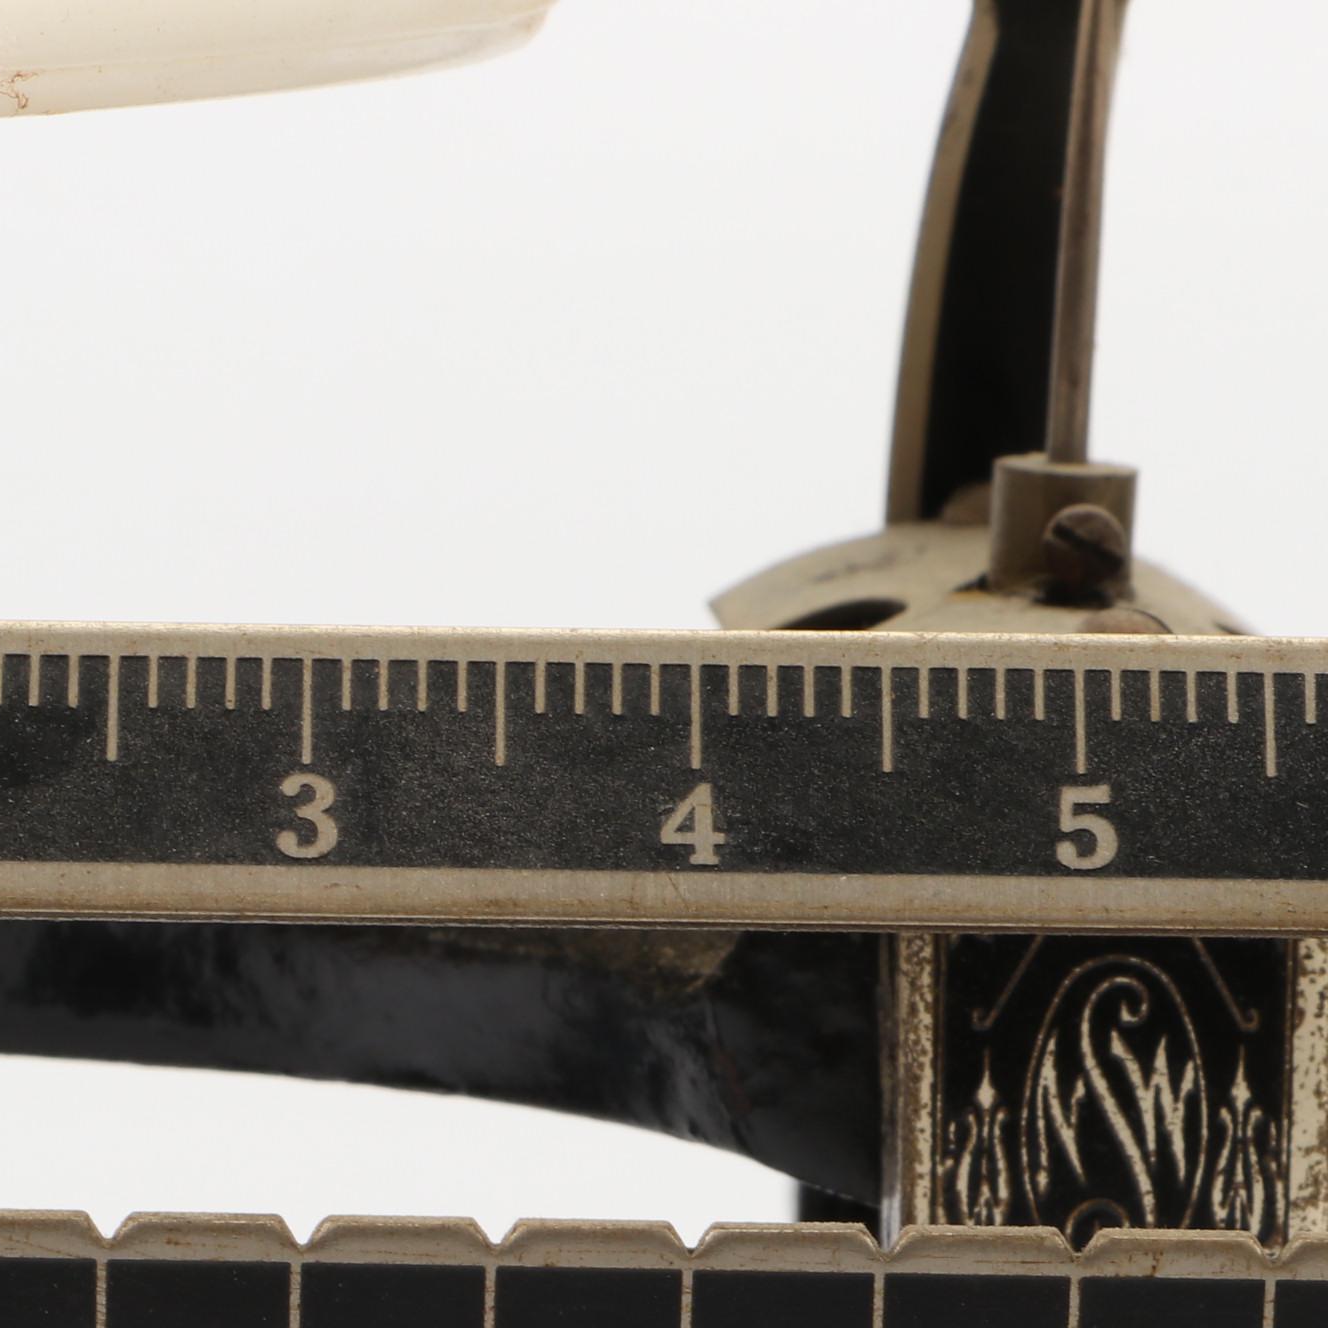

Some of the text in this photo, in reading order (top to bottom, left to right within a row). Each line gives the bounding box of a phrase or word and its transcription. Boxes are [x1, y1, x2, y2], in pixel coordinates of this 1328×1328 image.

[276, 773, 339, 859] 3
[659, 781, 726, 866] 4
[1056, 784, 1118, 871] 5
